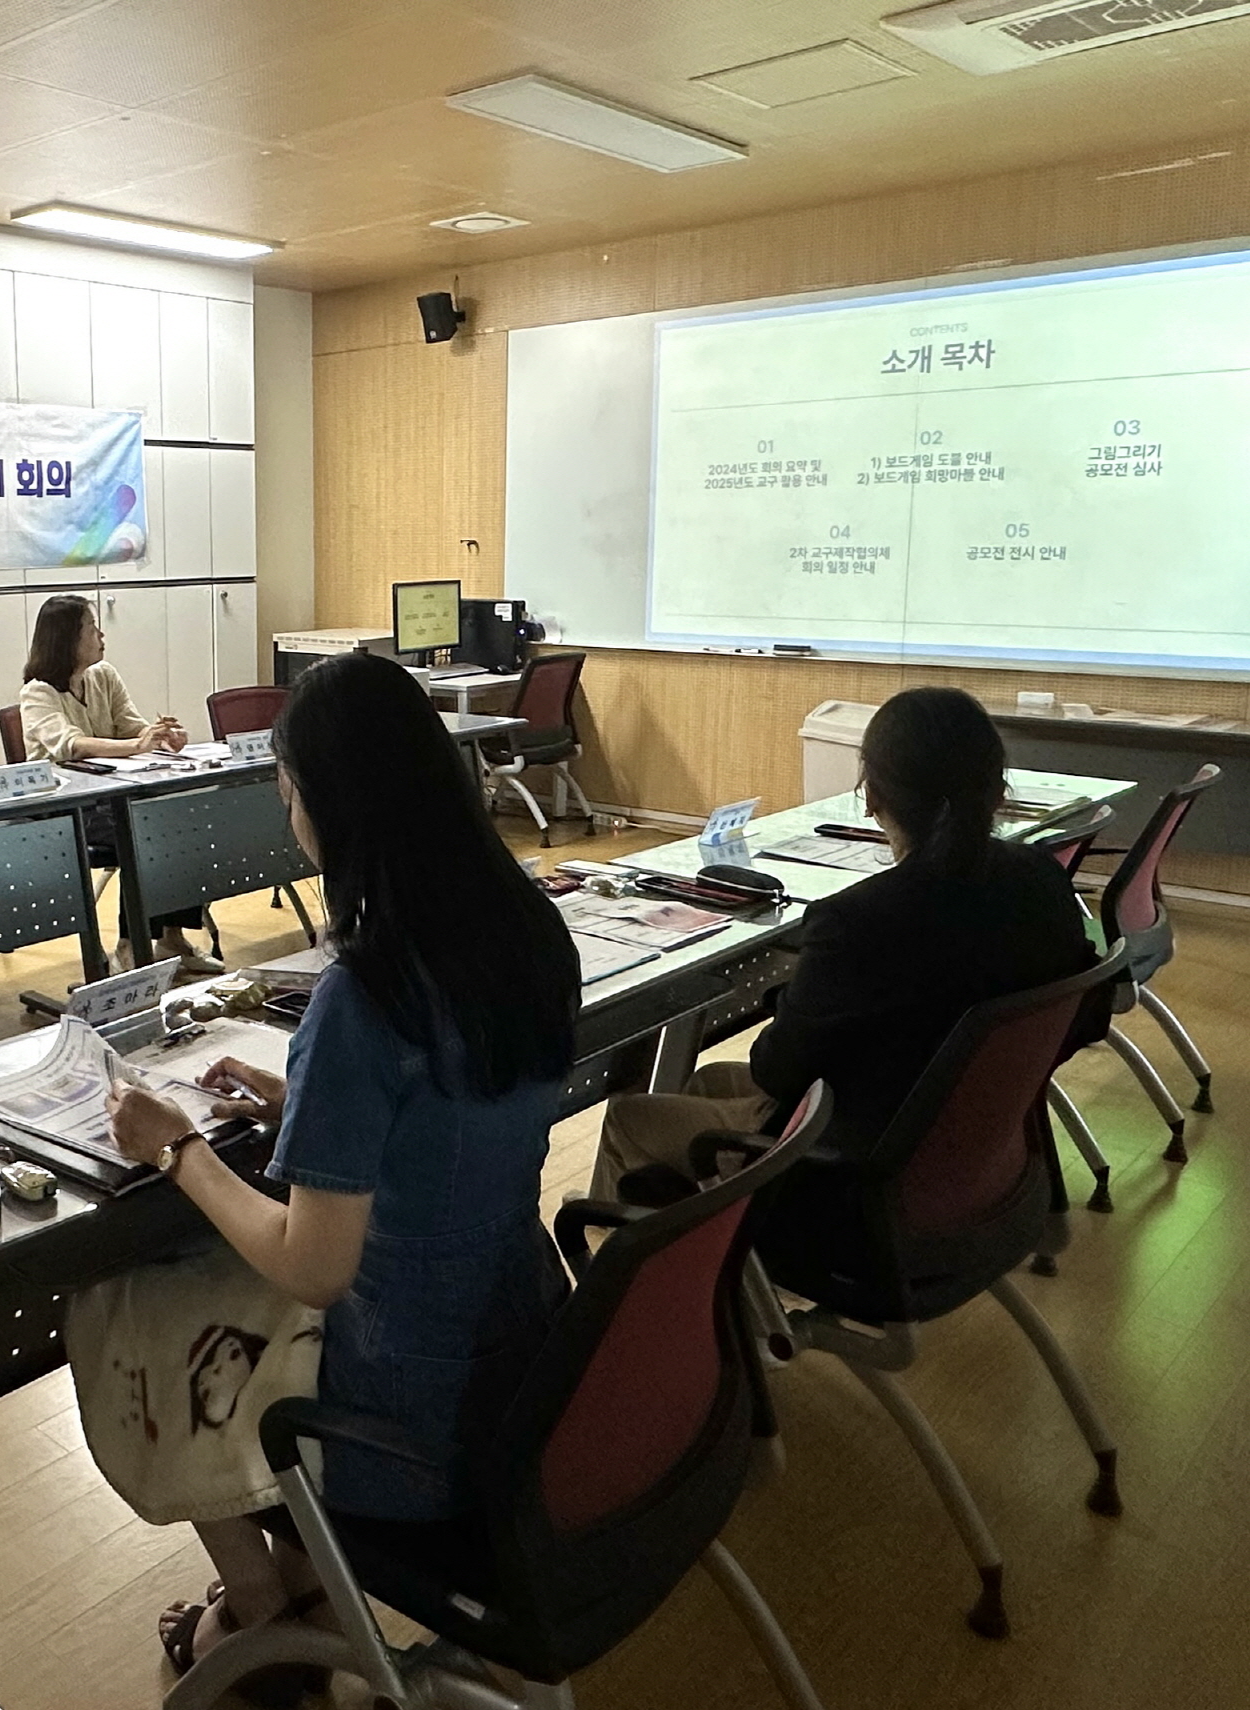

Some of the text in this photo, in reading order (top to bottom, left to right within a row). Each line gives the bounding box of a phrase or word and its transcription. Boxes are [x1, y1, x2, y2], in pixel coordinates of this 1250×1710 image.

[909, 322, 969, 337] CONTENTS
[880, 339, 996, 374] 소개 목차
[1113, 420, 1141, 437] 03
[920, 430, 944, 446] 02
[757, 440, 774, 454] 01
[1087, 443, 1162, 461] 그림그리기
[708, 462, 759, 476] 2024년도
[761, 461, 783, 474] 회의
[785, 459, 808, 473] 요약
[871, 456, 882, 471] 1)
[885, 453, 934, 468] 보드게임
[965, 451, 992, 466] 안내
[1085, 461, 1163, 478] 공모전 심사
[15, 458, 73, 499] 회의
[704, 476, 755, 490] 2025년도
[756, 475, 778, 488] 교구
[805, 473, 828, 487] 안내
[857, 472, 870, 486] 2)
[873, 469, 922, 485] 보드게임
[978, 466, 1005, 482] 안내
[829, 524, 851, 540] 04
[1004, 523, 1030, 539] 05
[789, 546, 808, 560] 2차
[965, 545, 1067, 561] 공모전 전시 안내
[801, 560, 876, 575] 회의 일정 안내
